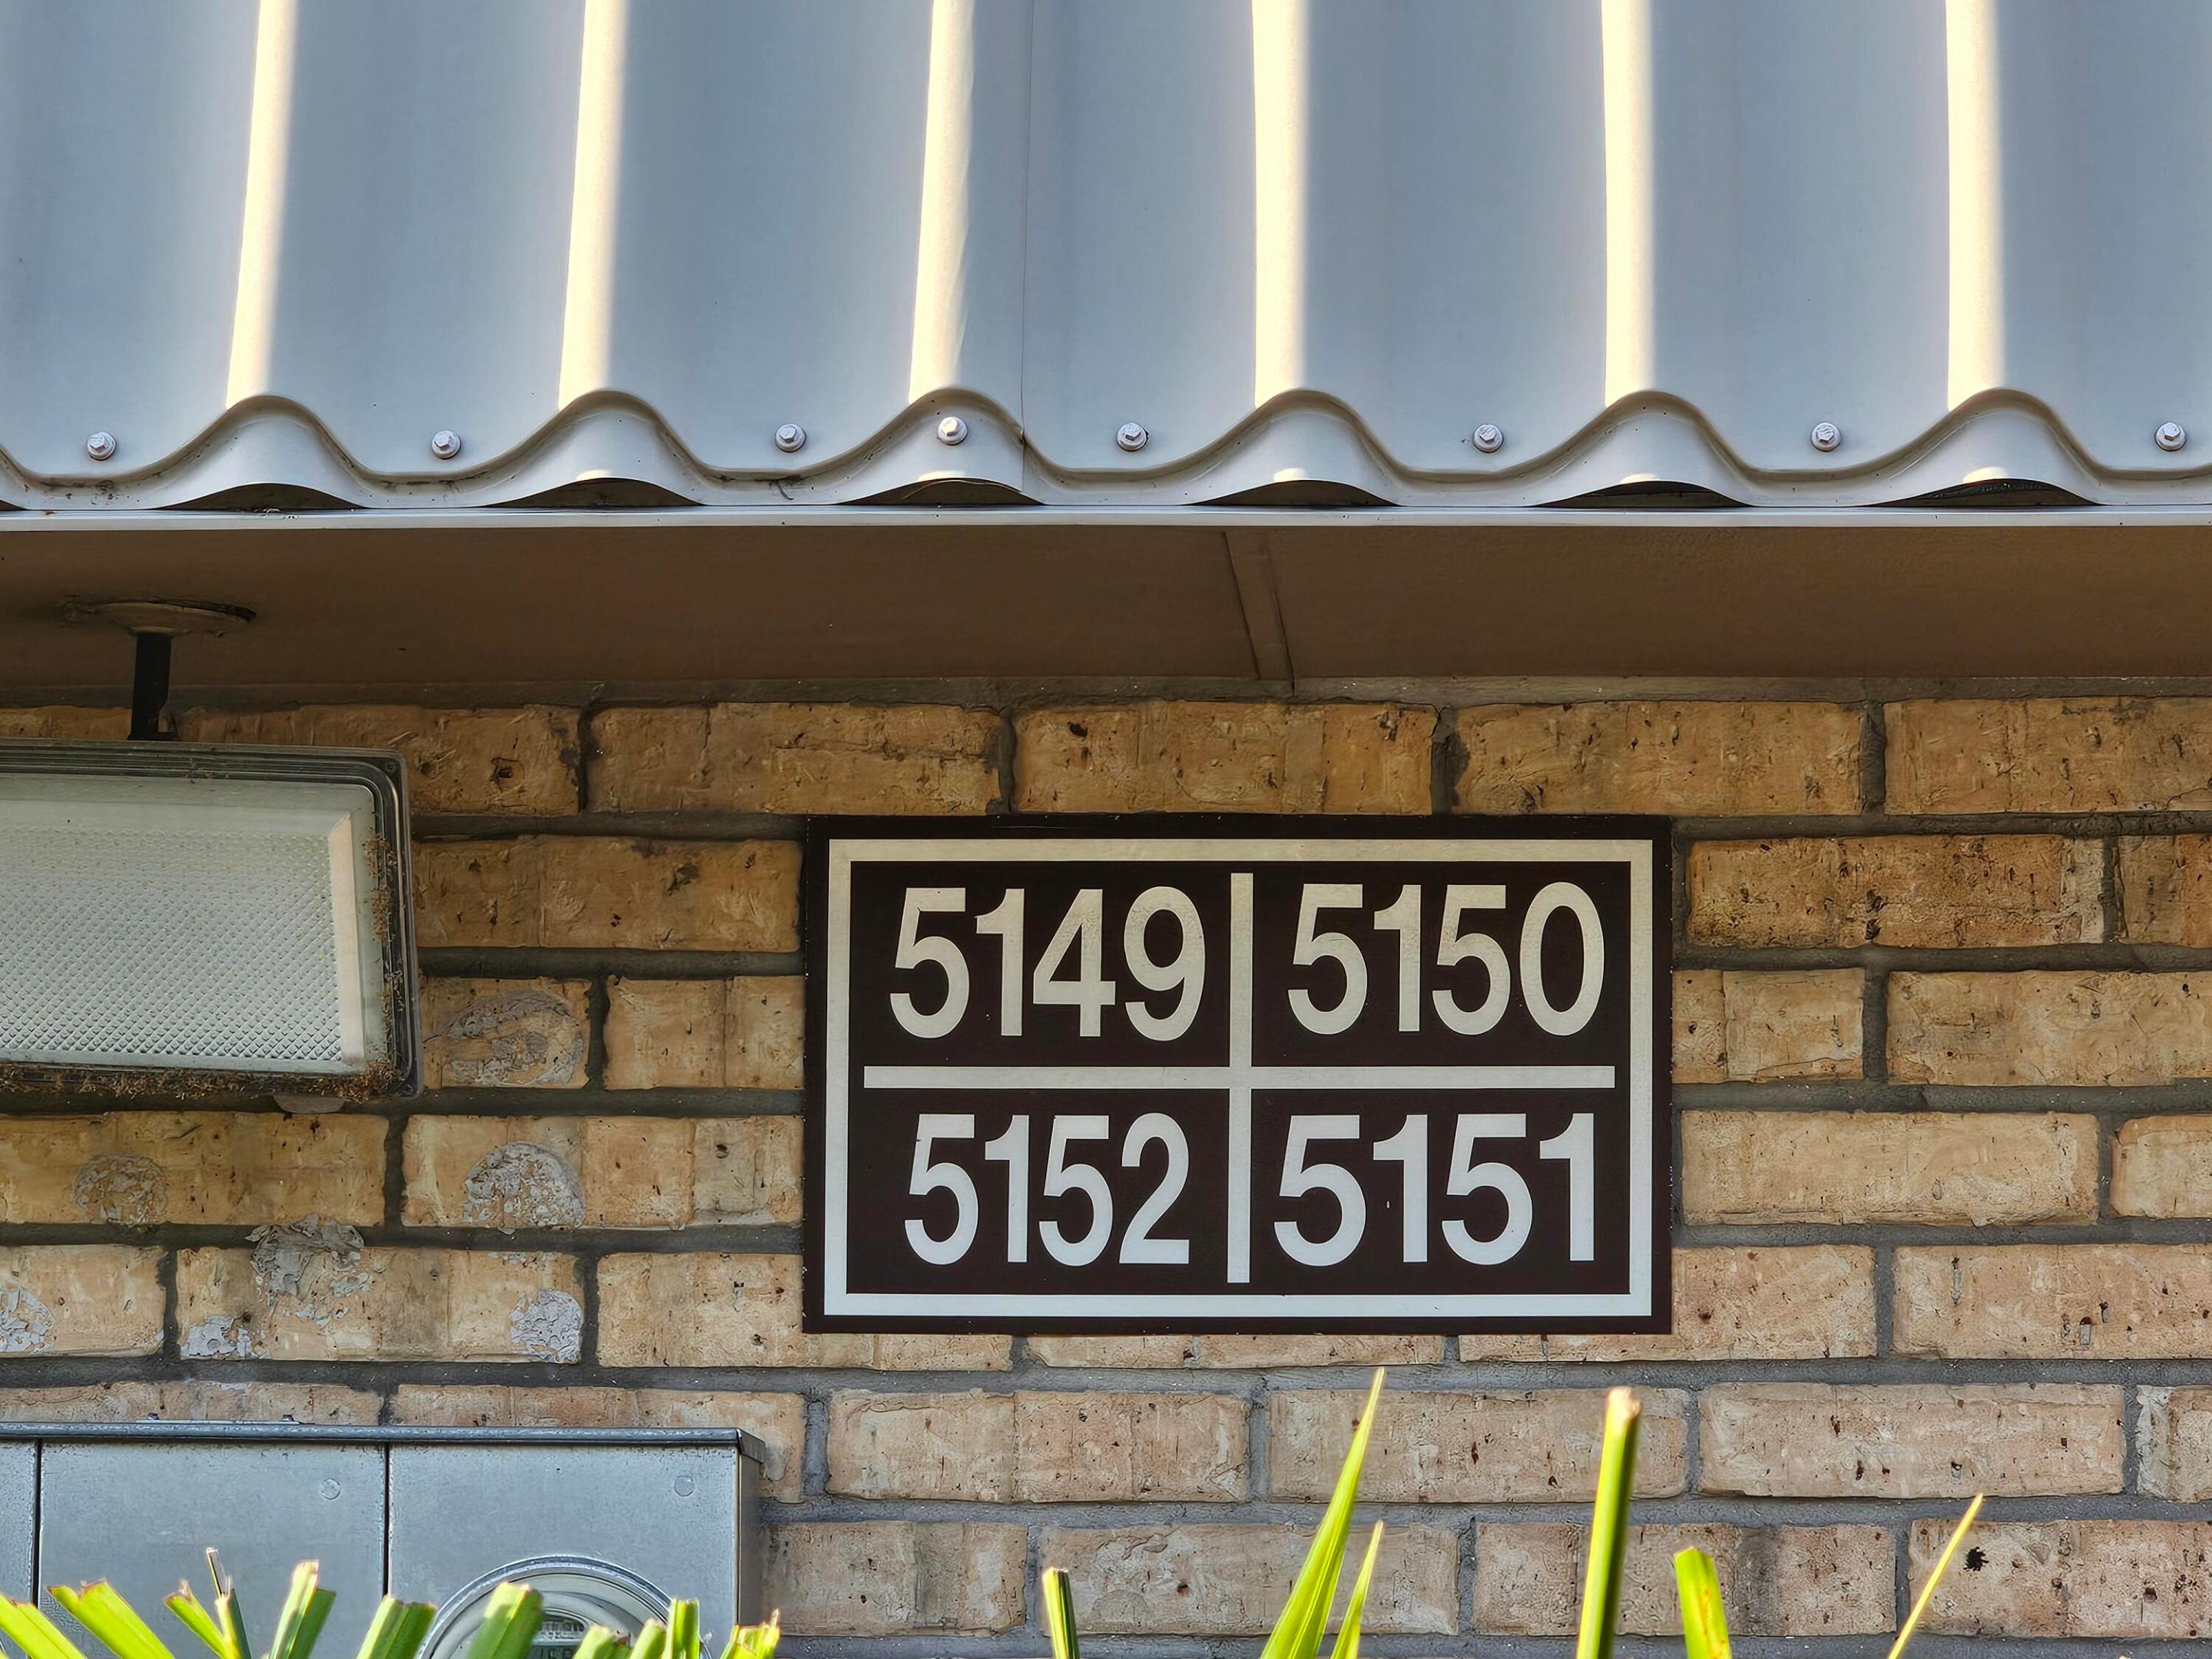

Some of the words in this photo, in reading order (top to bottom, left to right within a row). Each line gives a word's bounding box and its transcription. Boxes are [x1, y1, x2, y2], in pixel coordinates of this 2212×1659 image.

[889, 886, 1206, 1041] 5149
[1287, 882, 1604, 1036] 5150
[904, 1112, 1190, 1267] 5152
[1273, 1113, 1594, 1267] 5151
